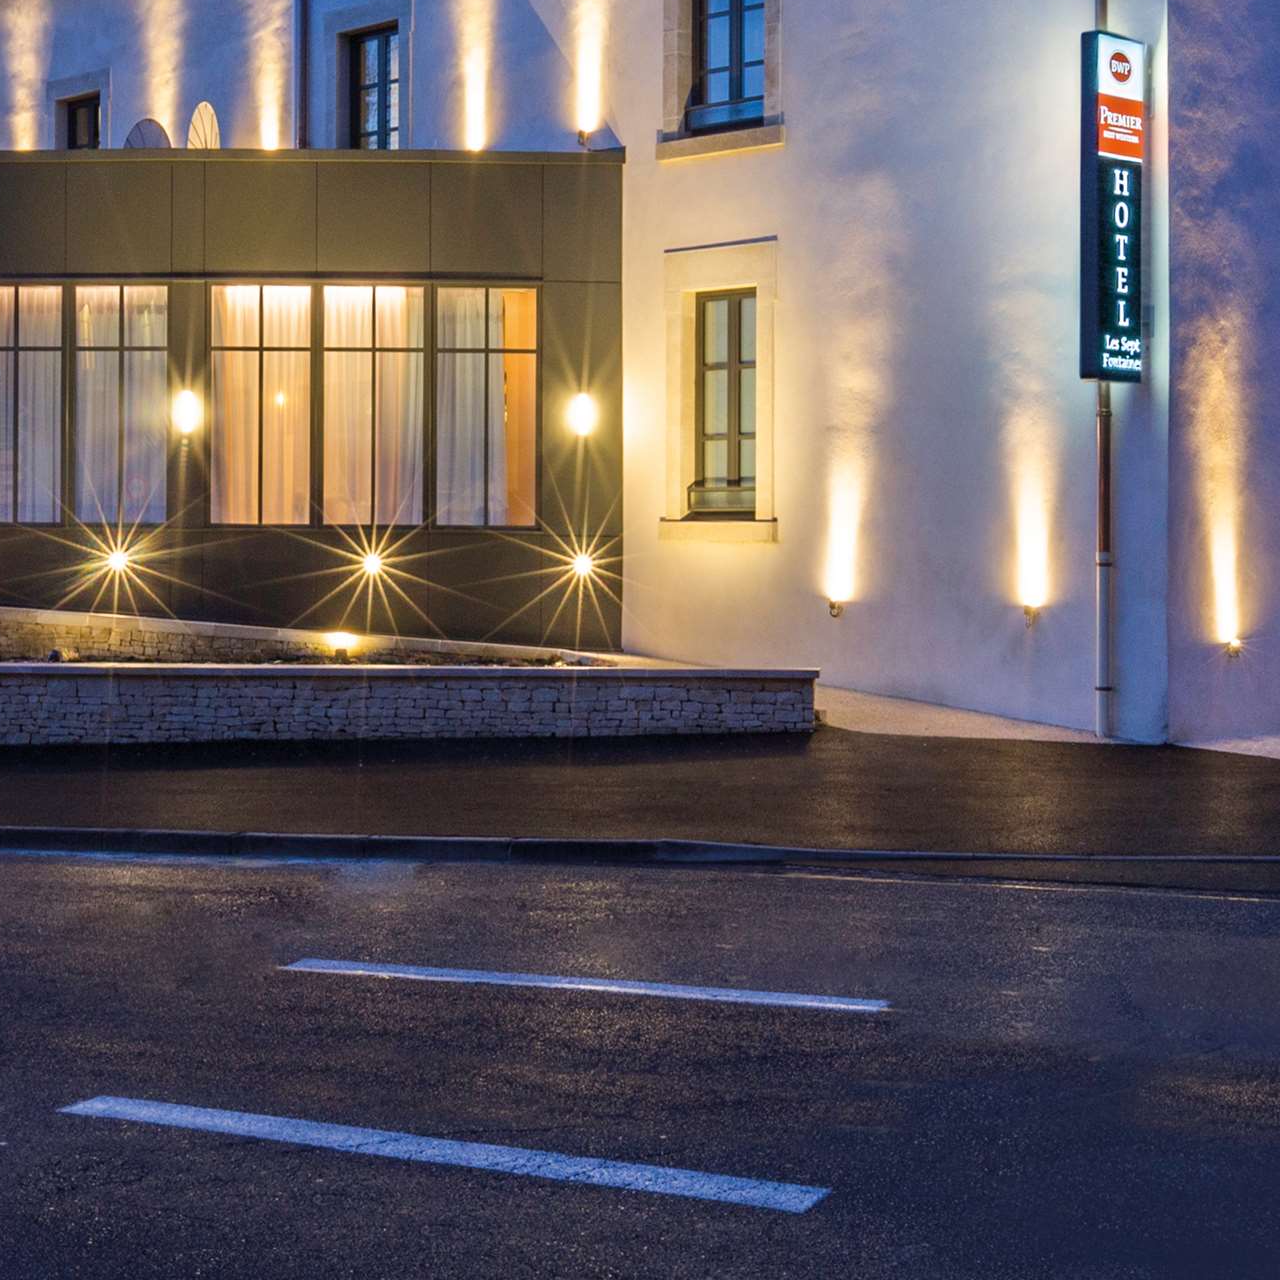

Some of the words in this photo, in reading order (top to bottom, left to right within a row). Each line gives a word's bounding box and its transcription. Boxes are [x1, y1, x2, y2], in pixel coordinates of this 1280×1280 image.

[1111, 59, 1130, 75] BWP
[1113, 169, 1130, 327] HOTEL
[1105, 334, 1120, 351] Les
[1120, 336, 1141, 356] Sept
